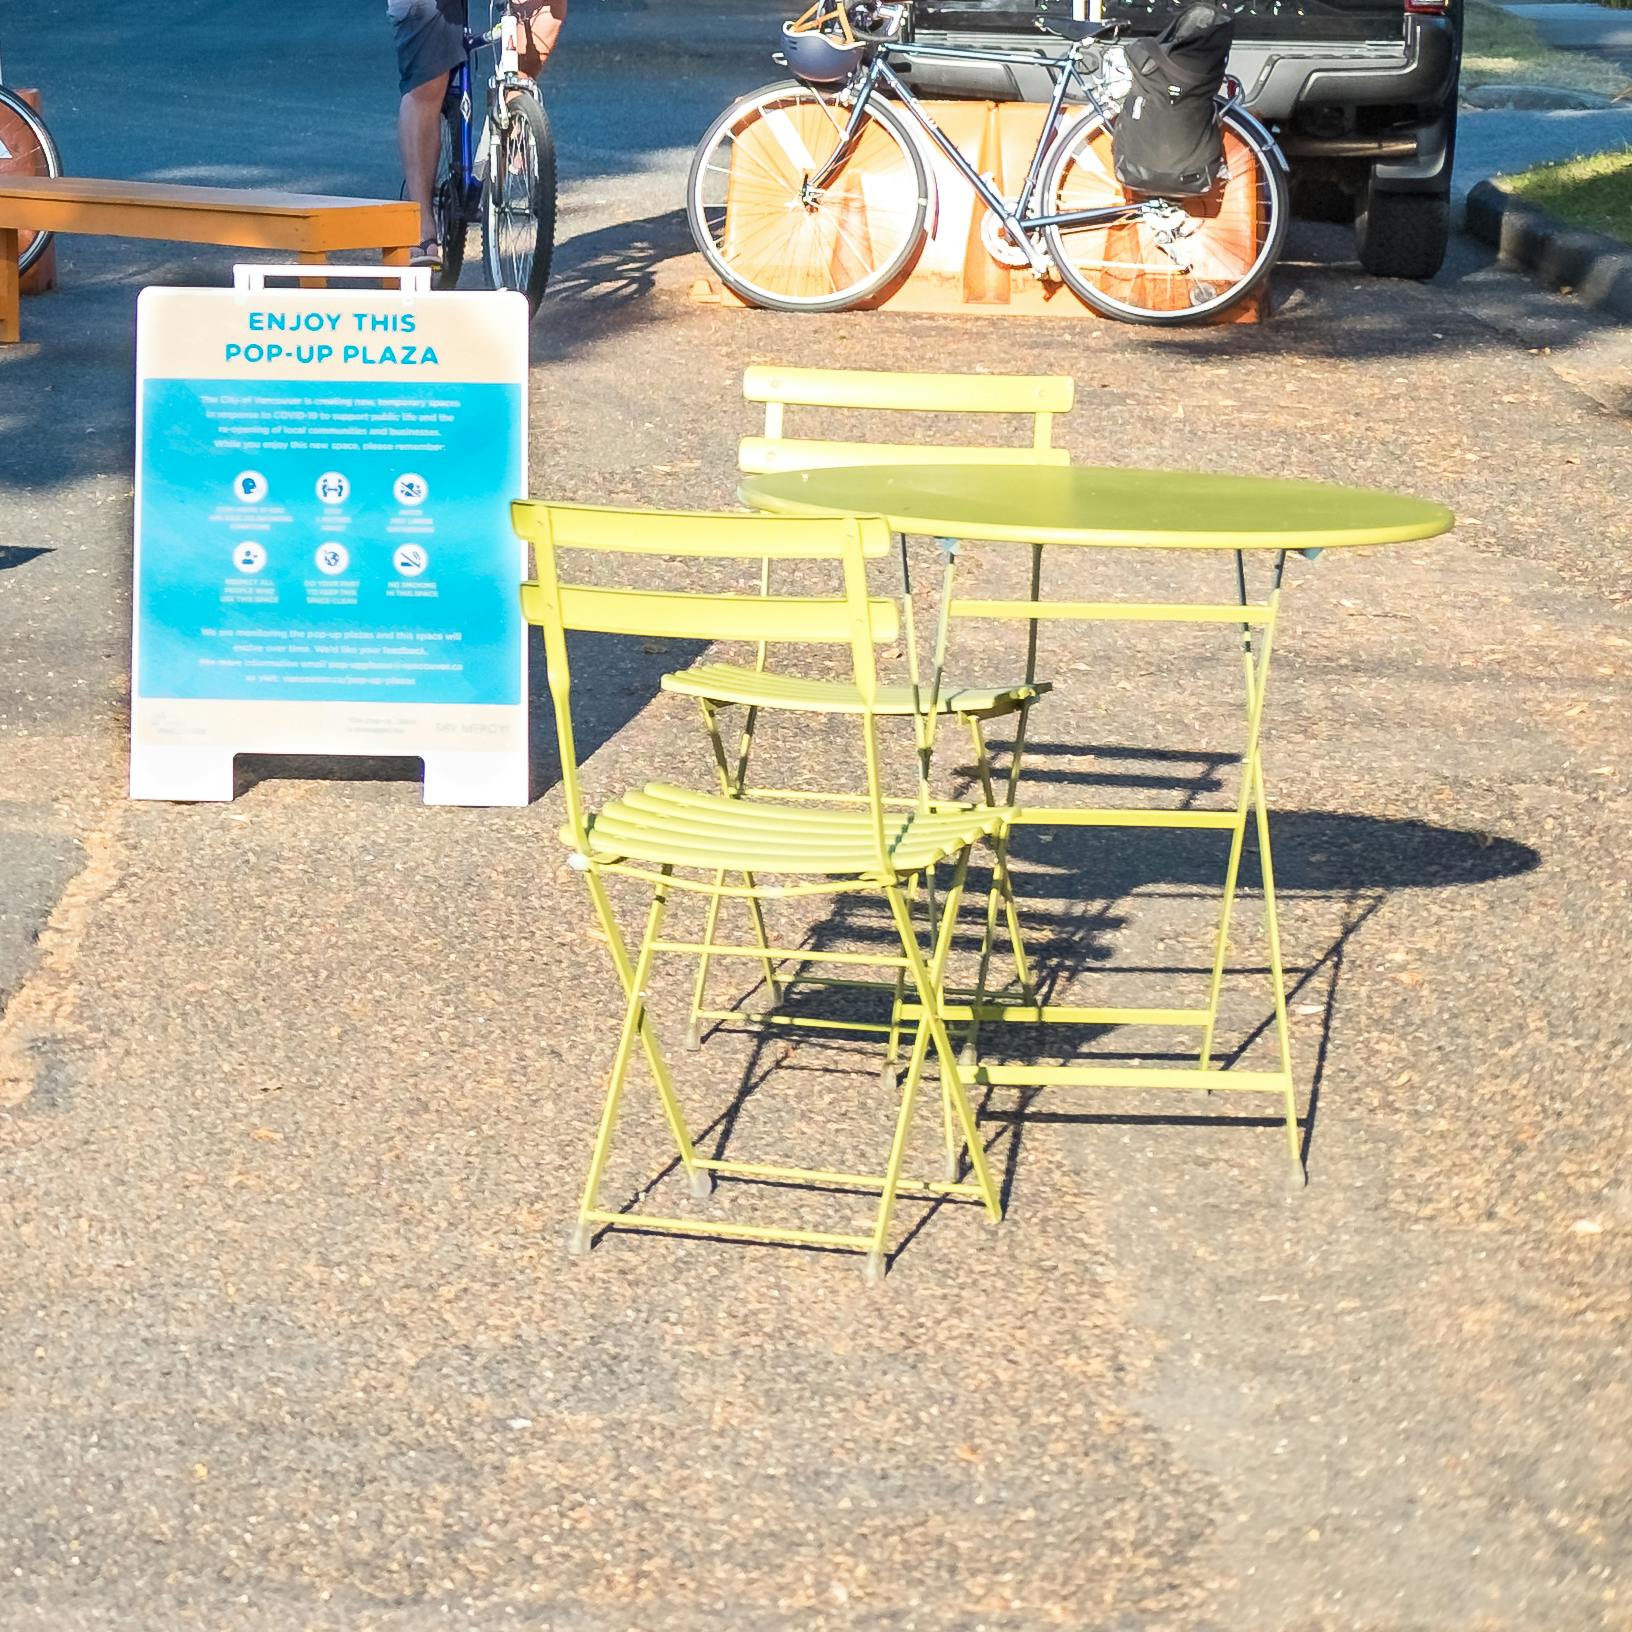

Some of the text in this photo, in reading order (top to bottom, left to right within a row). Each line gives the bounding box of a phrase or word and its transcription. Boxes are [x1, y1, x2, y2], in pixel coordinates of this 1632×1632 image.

[248, 311, 416, 332] ENJOY THIS
[225, 343, 439, 364] POP-UP PLAZA
